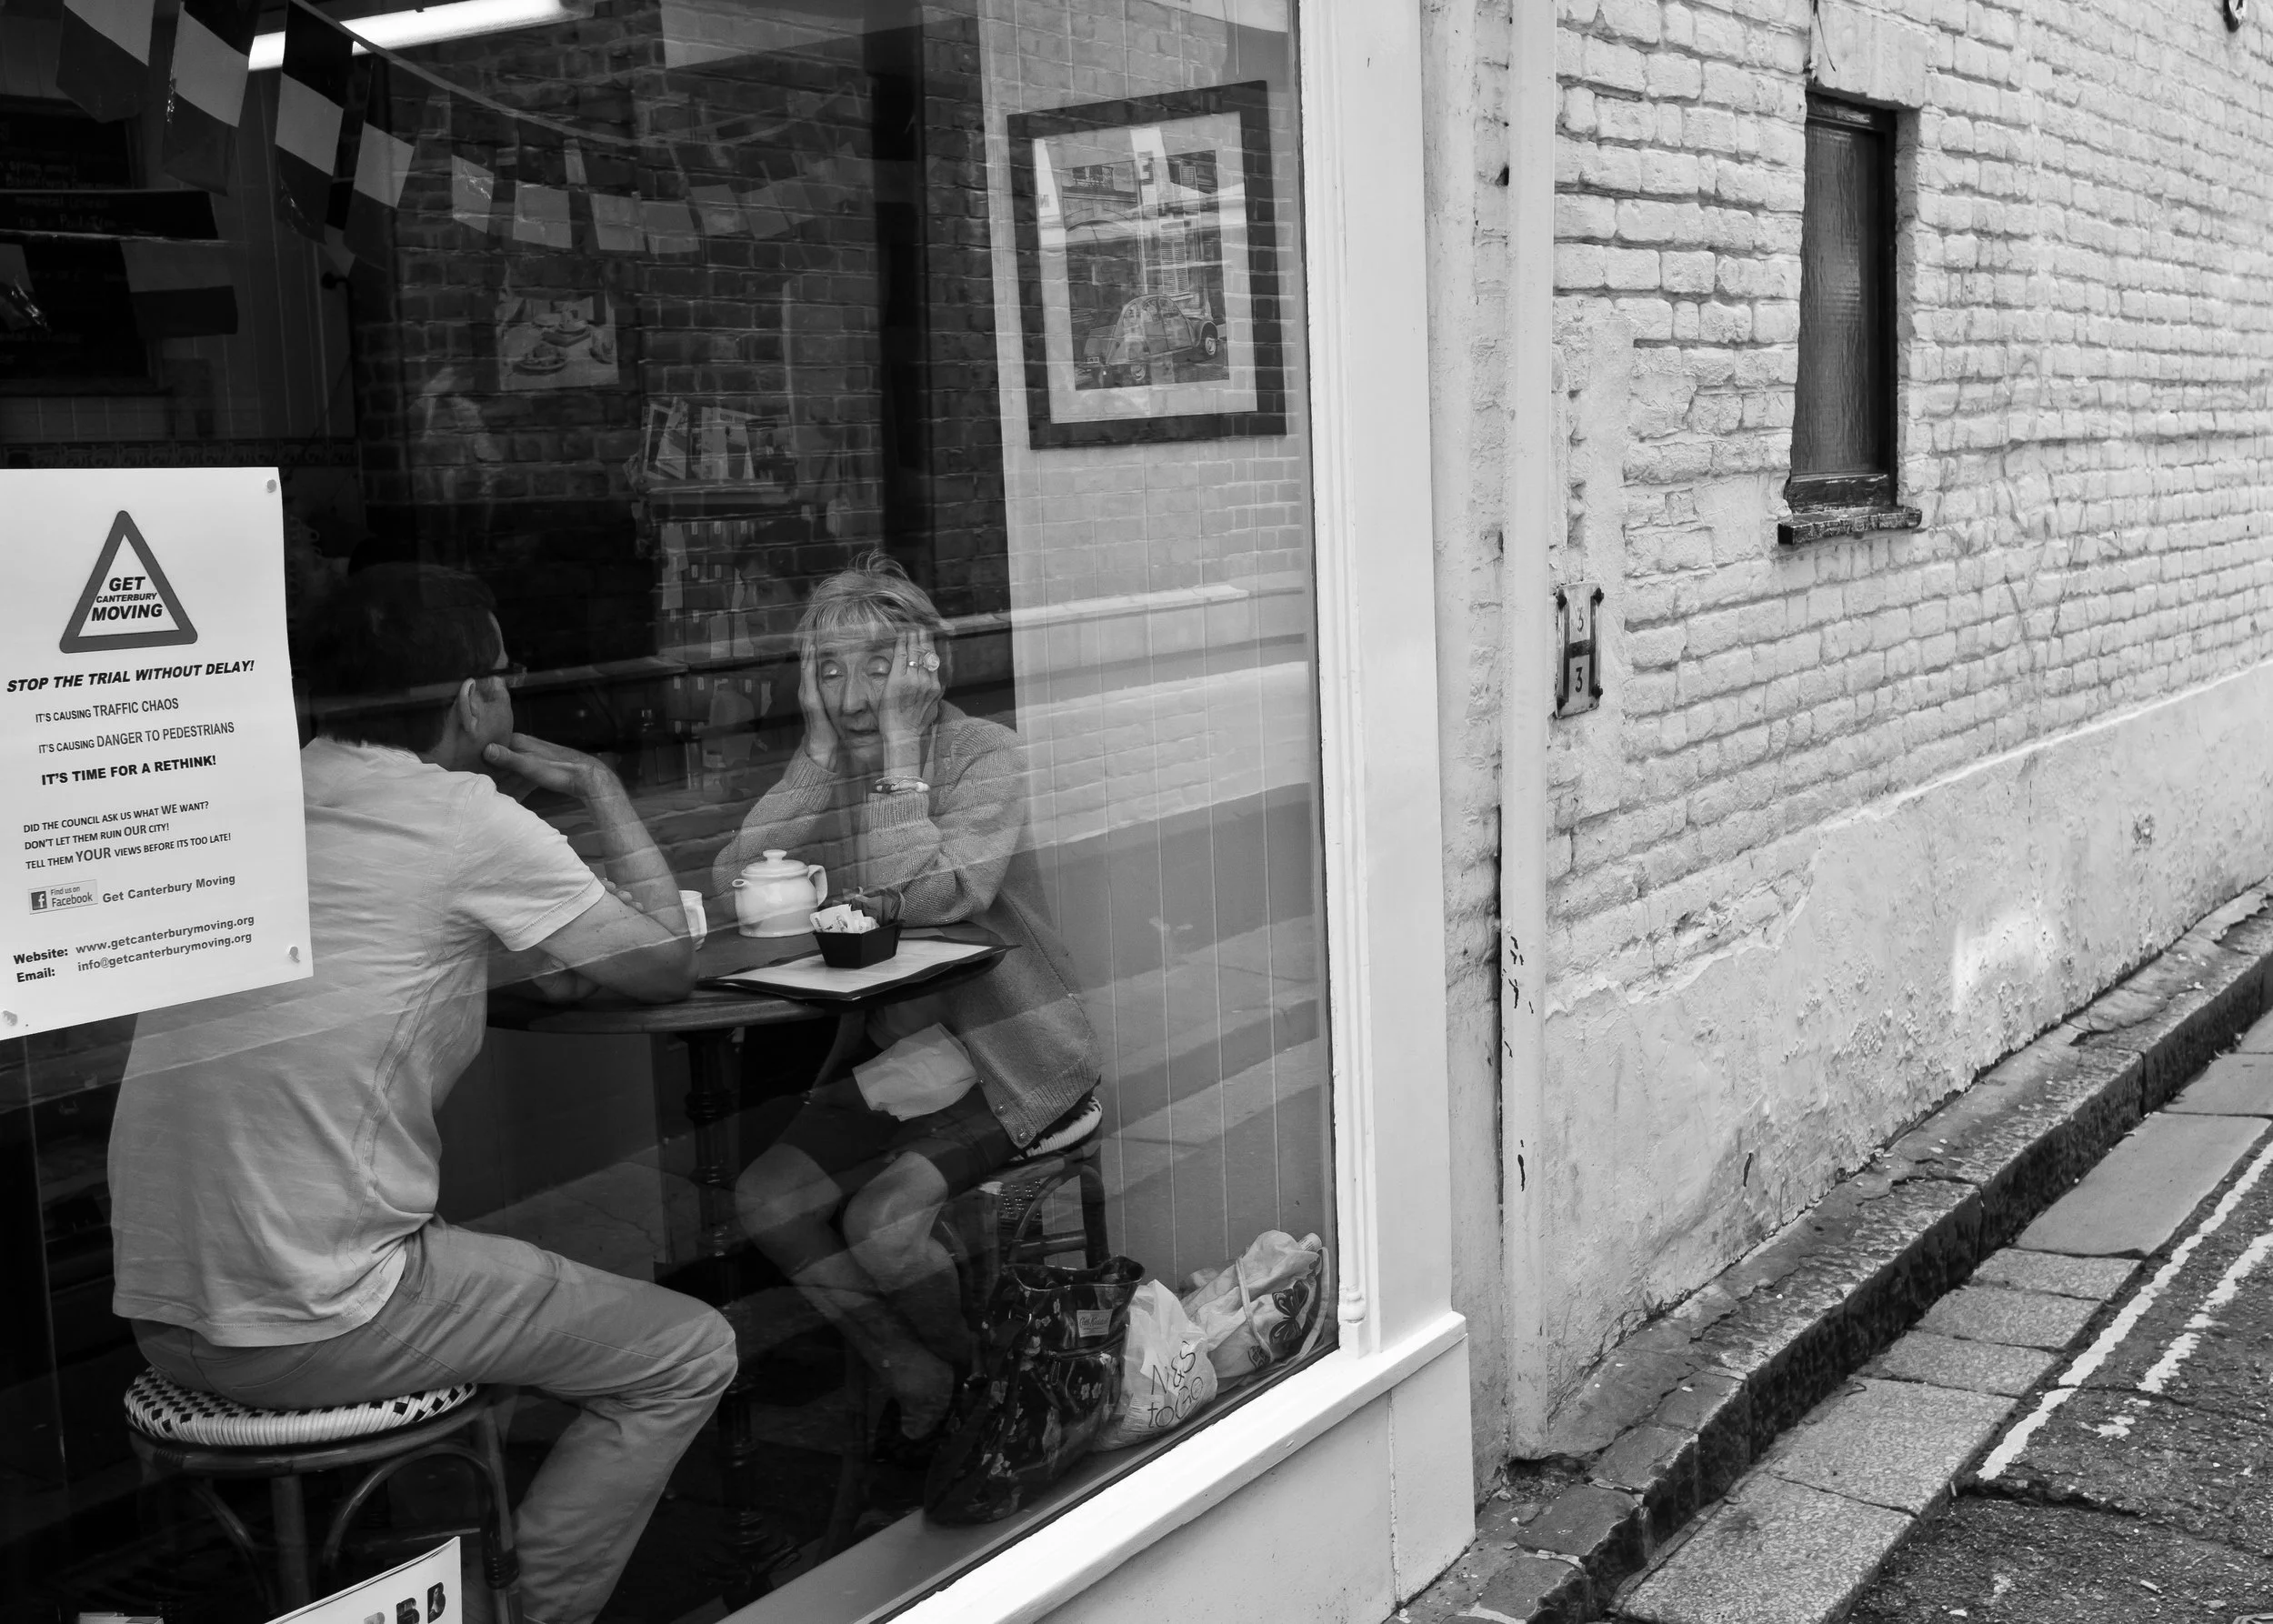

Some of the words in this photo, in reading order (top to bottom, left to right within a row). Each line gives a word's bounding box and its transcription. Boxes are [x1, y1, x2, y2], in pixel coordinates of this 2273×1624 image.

[108, 576, 145, 591] GET
[95, 593, 157, 604] CANTERBURY
[91, 604, 163, 621] MOVING
[1577, 606, 1584, 633] 3
[6, 677, 49, 693] STOP
[54, 675, 84, 688] THE
[88, 671, 131, 685] TRIAL
[135, 664, 203, 681] WITHOUT
[205, 660, 255, 675] DELAY!
[1575, 667, 1583, 693] 3
[35, 713, 52, 722] IT'S
[53, 709, 91, 720] CAUSING
[93, 702, 139, 717] TRAFFIC
[142, 698, 179, 712] CHAOS
[38, 744, 55, 753] IT'S
[56, 740, 95, 751] CAUSING
[96, 731, 143, 747] DANGER
[145, 729, 160, 742] TO
[163, 722, 235, 740] PEDESTRIANS
[41, 773, 68, 786] IT'S
[72, 767, 106, 782] TIME
[110, 764, 138, 777] FOR
[142, 763, 151, 773] A
[155, 755, 216, 772] RETHINK!
[24, 824, 40, 833] DID
[42, 821, 59, 830] THE
[61, 817, 100, 827] COUNCIL
[102, 814, 118, 823] ASK
[120, 812, 132, 820] US
[134, 807, 159, 818] WHAT
[161, 804, 177, 815] WE
[179, 800, 209, 812] WANT?
[25, 838, 54, 849] DON'T
[55, 837, 70, 846] LET
[73, 833, 98, 844] THEM
[100, 829, 122, 839] RUIN
[124, 825, 146, 837] OUR
[148, 822, 170, 833] CITY!
[25, 861, 45, 869] TELL
[47, 855, 74, 866] THEM
[75, 847, 112, 862] YOUR
[114, 847, 142, 857] VIEWS
[144, 840, 175, 853] BEFORE
[176, 838, 189, 847] ITS
[190, 837, 208, 846] TOO
[209, 833, 231, 844] LATE!
[52, 892, 93, 907] Facebook
[102, 891, 124, 902] Get
[127, 882, 193, 898] Canterbury
[195, 876, 235, 888] Moving
[13, 947, 68, 965] Website:
[75, 917, 255, 953] www.getcanterburymoving.org
[16, 967, 55, 982] Email:
[77, 933, 252, 971] info@getcanterburymoving.org
